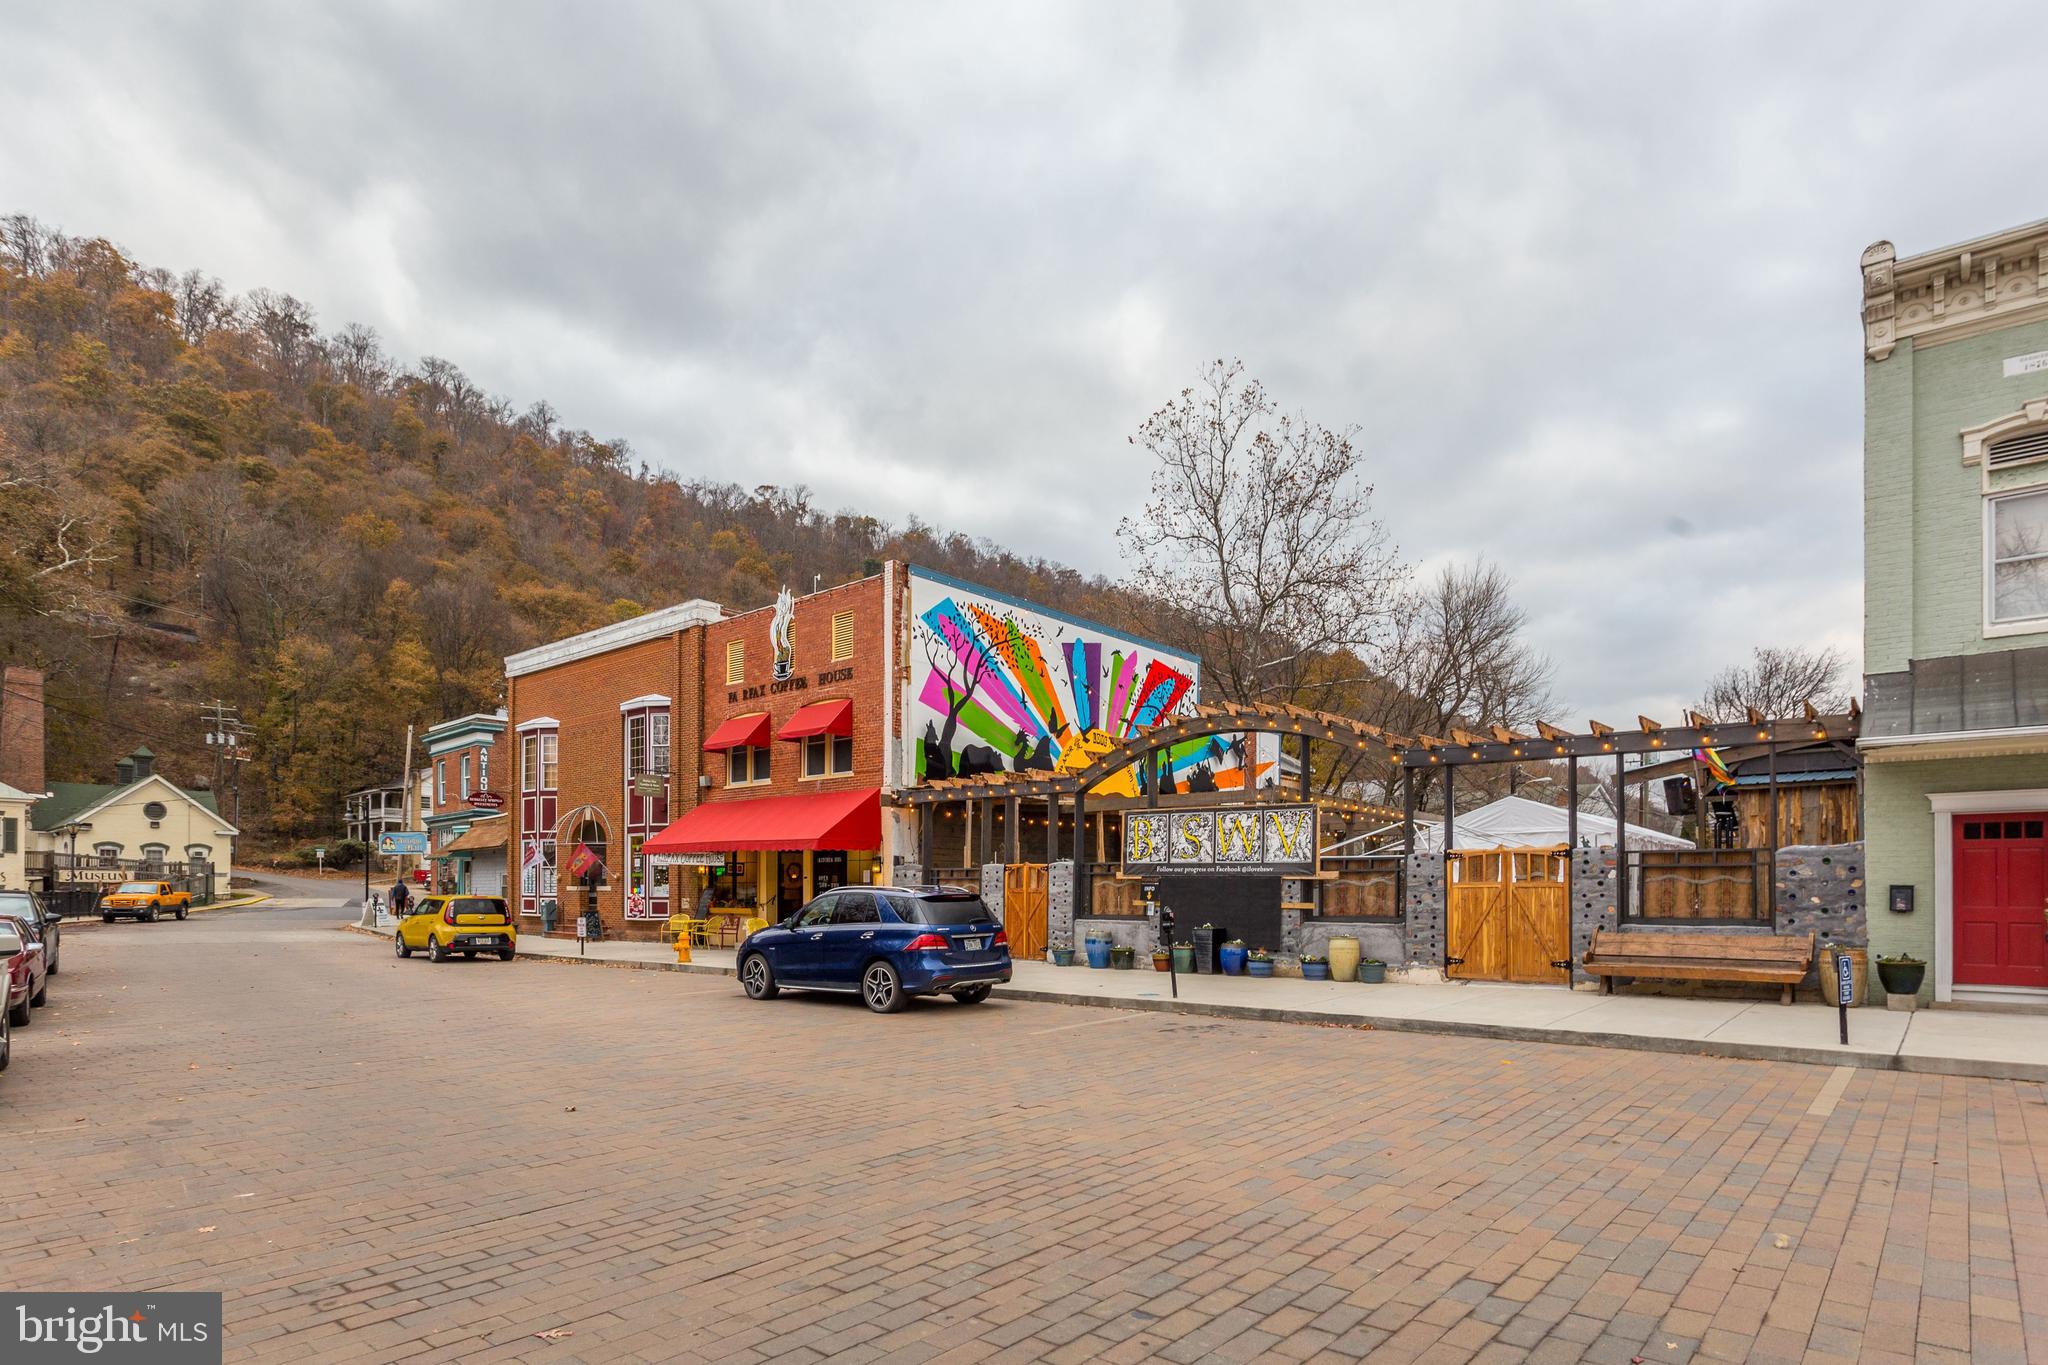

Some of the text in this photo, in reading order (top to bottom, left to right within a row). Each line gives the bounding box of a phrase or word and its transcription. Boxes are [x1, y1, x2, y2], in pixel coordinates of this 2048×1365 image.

[770, 677, 808, 695] COFFEE
[818, 667, 854, 686] HOUSE
[480, 747, 488, 792] ANTIQU
[681, 852, 704, 864] COFFEE
[705, 851, 724, 864] HOUSE
[1156, 865, 1173, 873] Follow
[1184, 866, 1206, 875] progress
[1216, 865, 1240, 873] Facebook
